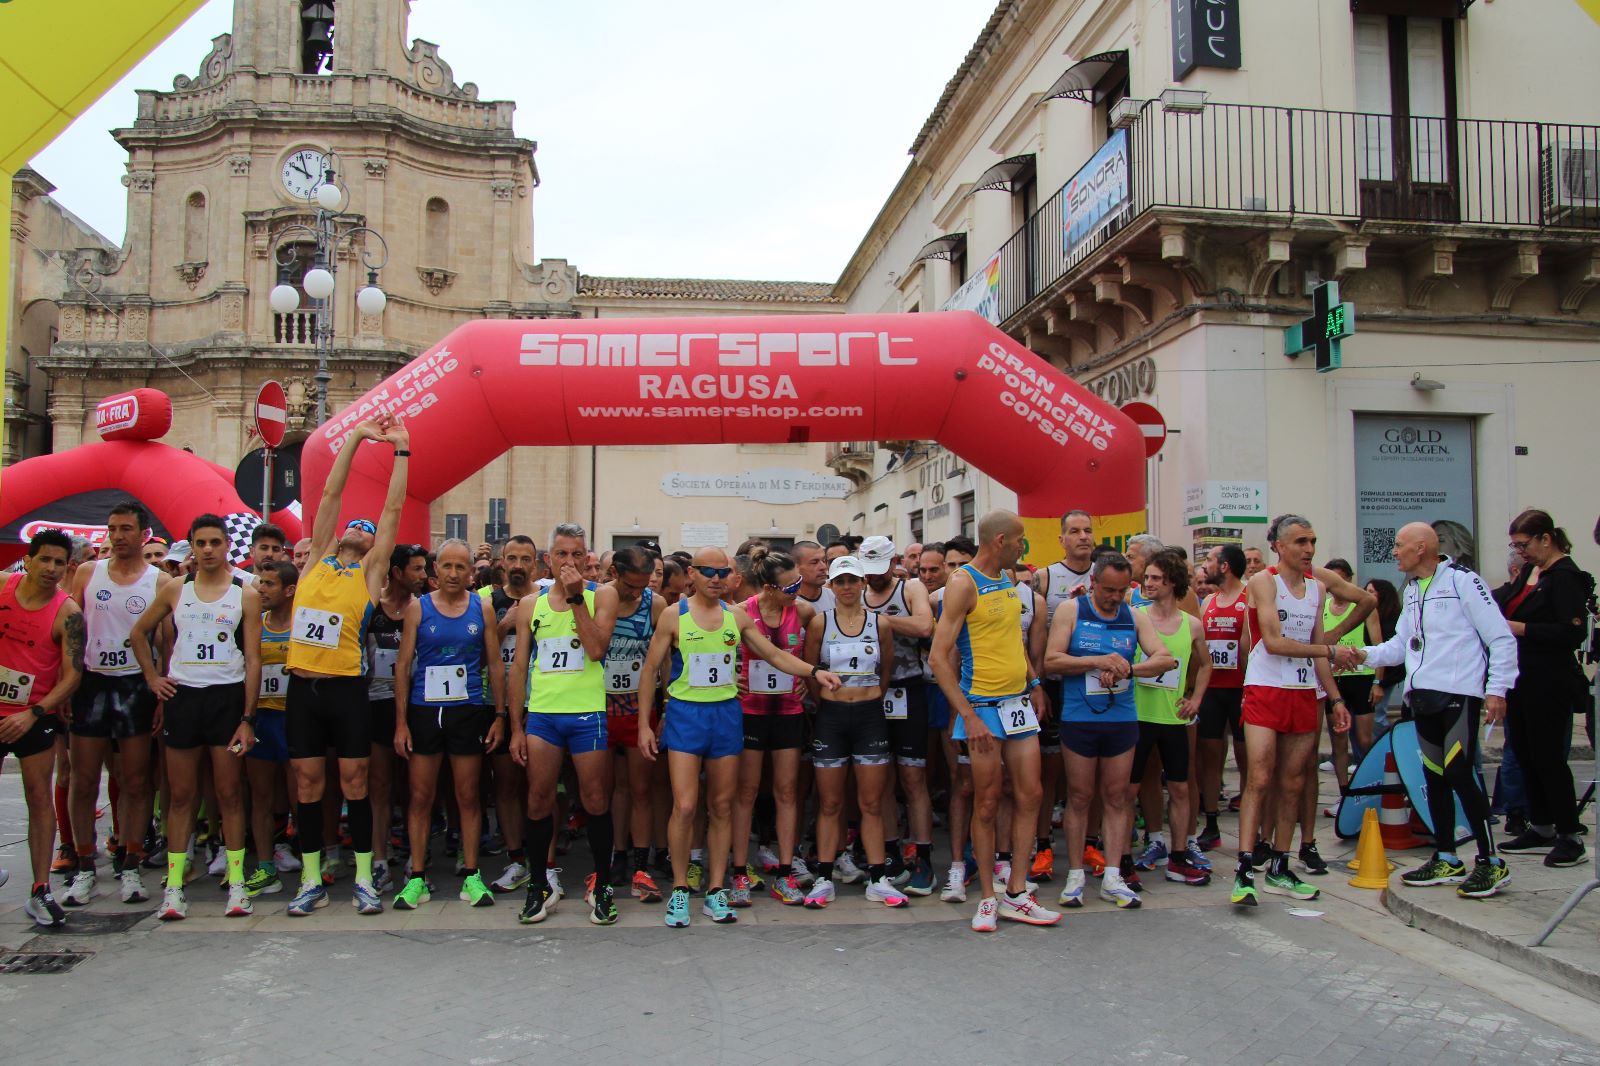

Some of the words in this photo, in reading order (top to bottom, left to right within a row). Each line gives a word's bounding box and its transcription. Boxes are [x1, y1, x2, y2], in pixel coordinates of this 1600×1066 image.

[1070, 149, 1126, 215] SONORA
[324, 388, 391, 439] GRAN
[395, 346, 453, 390] PRIX
[638, 374, 799, 400] RAGUSA
[988, 342, 1056, 394] GRAN
[1059, 392, 1117, 438] PRIX
[577, 403, 864, 419] www.samershop.com
[976, 354, 1109, 451] provinciale
[999, 391, 1070, 447] corsa
[1384, 427, 1442, 445] GOLD
[715, 478, 756, 489] OPERAIA
[305, 622, 326, 641] 24
[100, 650, 128, 667] 293
[197, 643, 215, 660] 31
[551, 651, 569, 669] 27
[849, 656, 859, 670] 4
[612, 673, 631, 689] 35
[708, 667, 719, 684] 3
[767, 673, 777, 690] 5
[1296, 667, 1308, 683] 12
[264, 677, 279, 693] 19
[442, 680, 450, 696] 1
[1010, 709, 1026, 728] 23
